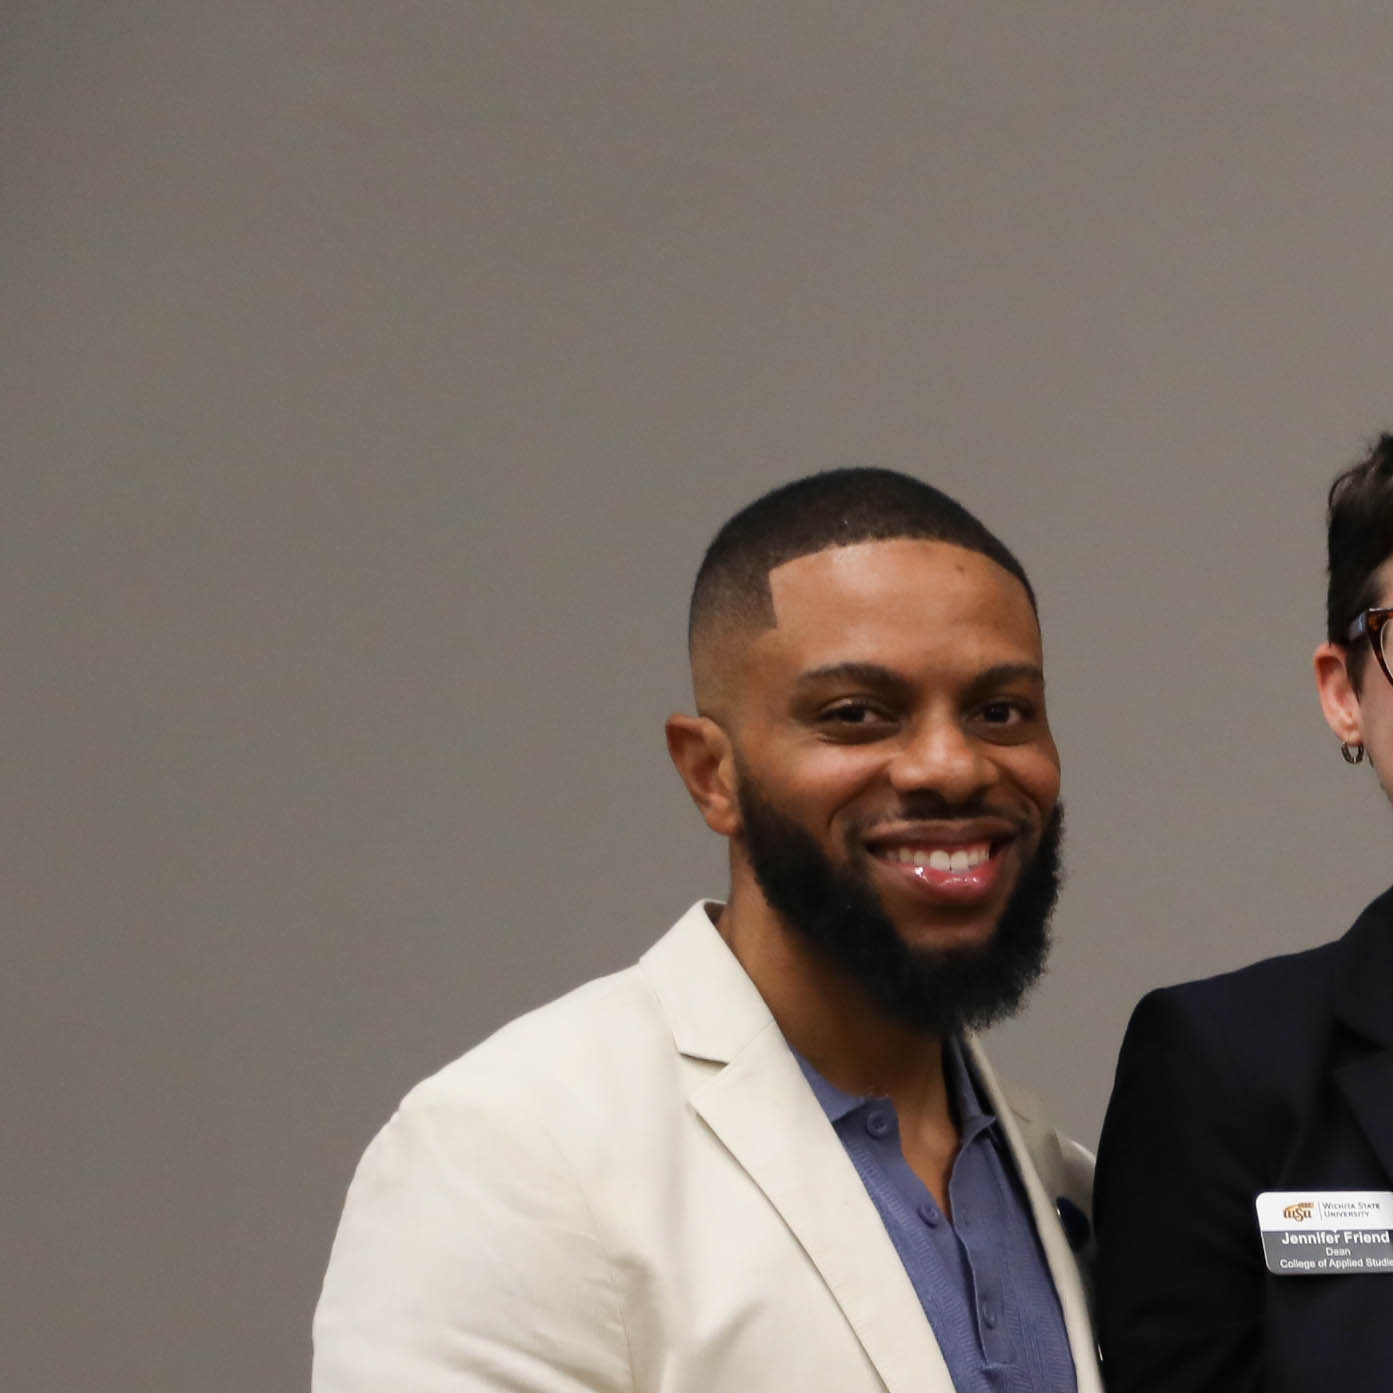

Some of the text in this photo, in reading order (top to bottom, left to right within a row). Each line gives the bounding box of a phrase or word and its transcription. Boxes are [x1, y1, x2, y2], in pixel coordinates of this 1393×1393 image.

[1281, 1231, 1390, 1245] Jennifer Friend
[1325, 1247, 1351, 1256] Dean
[1279, 1259, 1316, 1270] College
[1318, 1258, 1327, 1268] of
[1329, 1258, 1364, 1270] Applied
